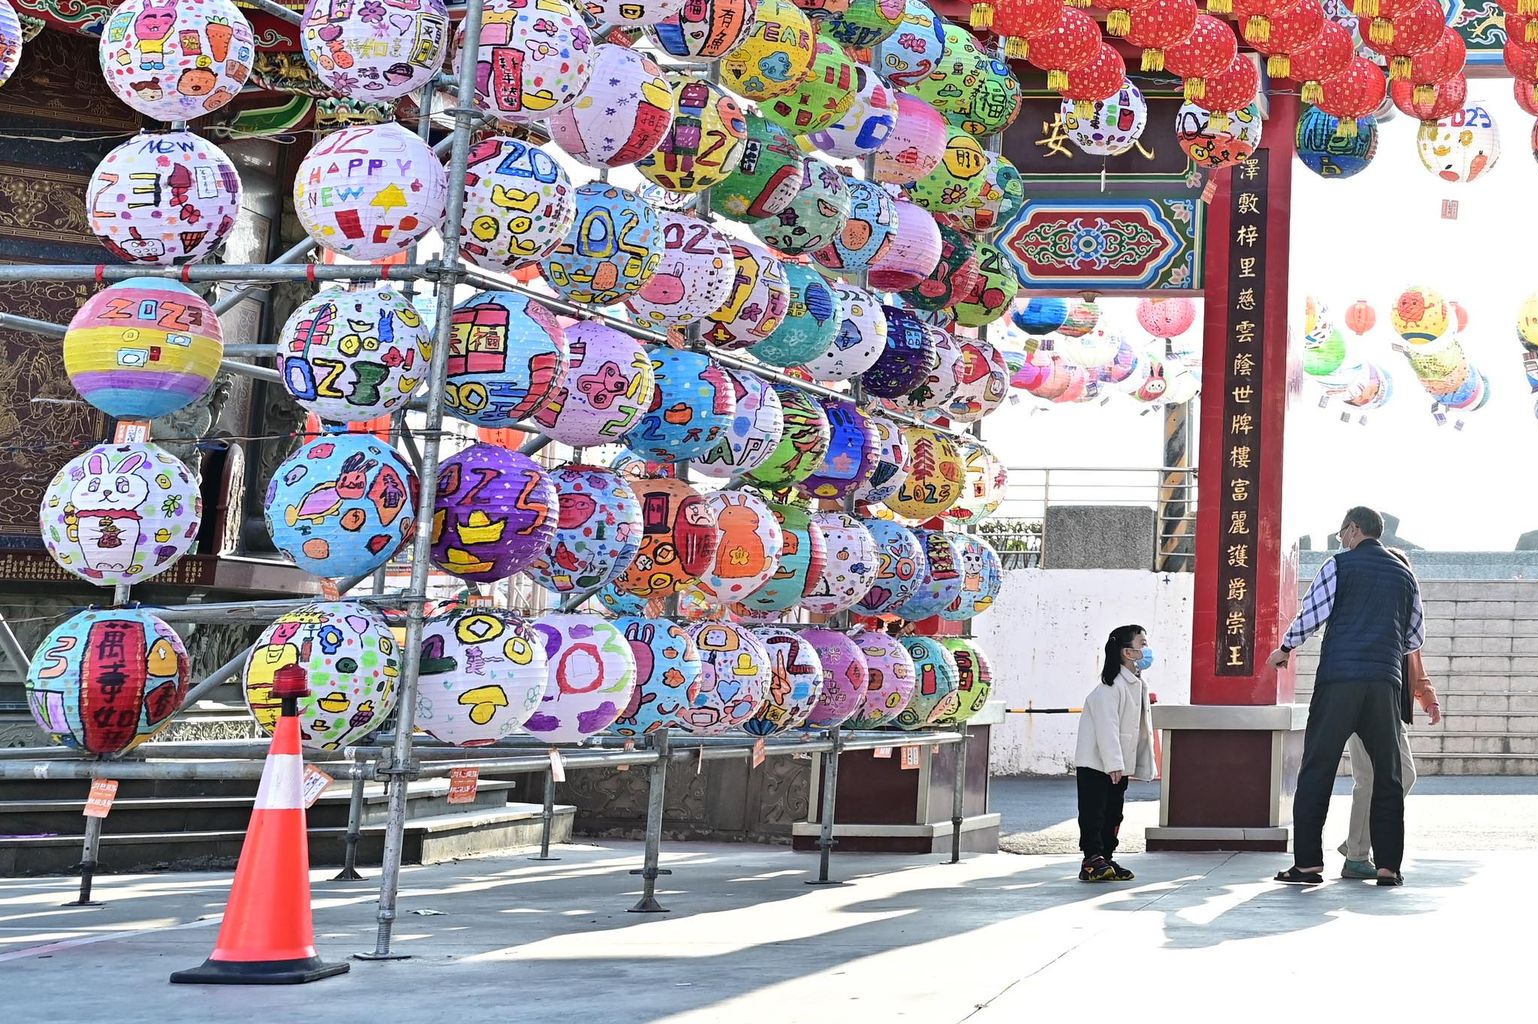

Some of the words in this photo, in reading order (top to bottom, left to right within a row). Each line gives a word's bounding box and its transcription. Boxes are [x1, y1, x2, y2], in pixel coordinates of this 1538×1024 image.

[138, 139, 195, 155] NEW
[308, 158, 414, 185] HAPPY
[308, 185, 365, 210] NEW
[97, 297, 203, 332] 2023
